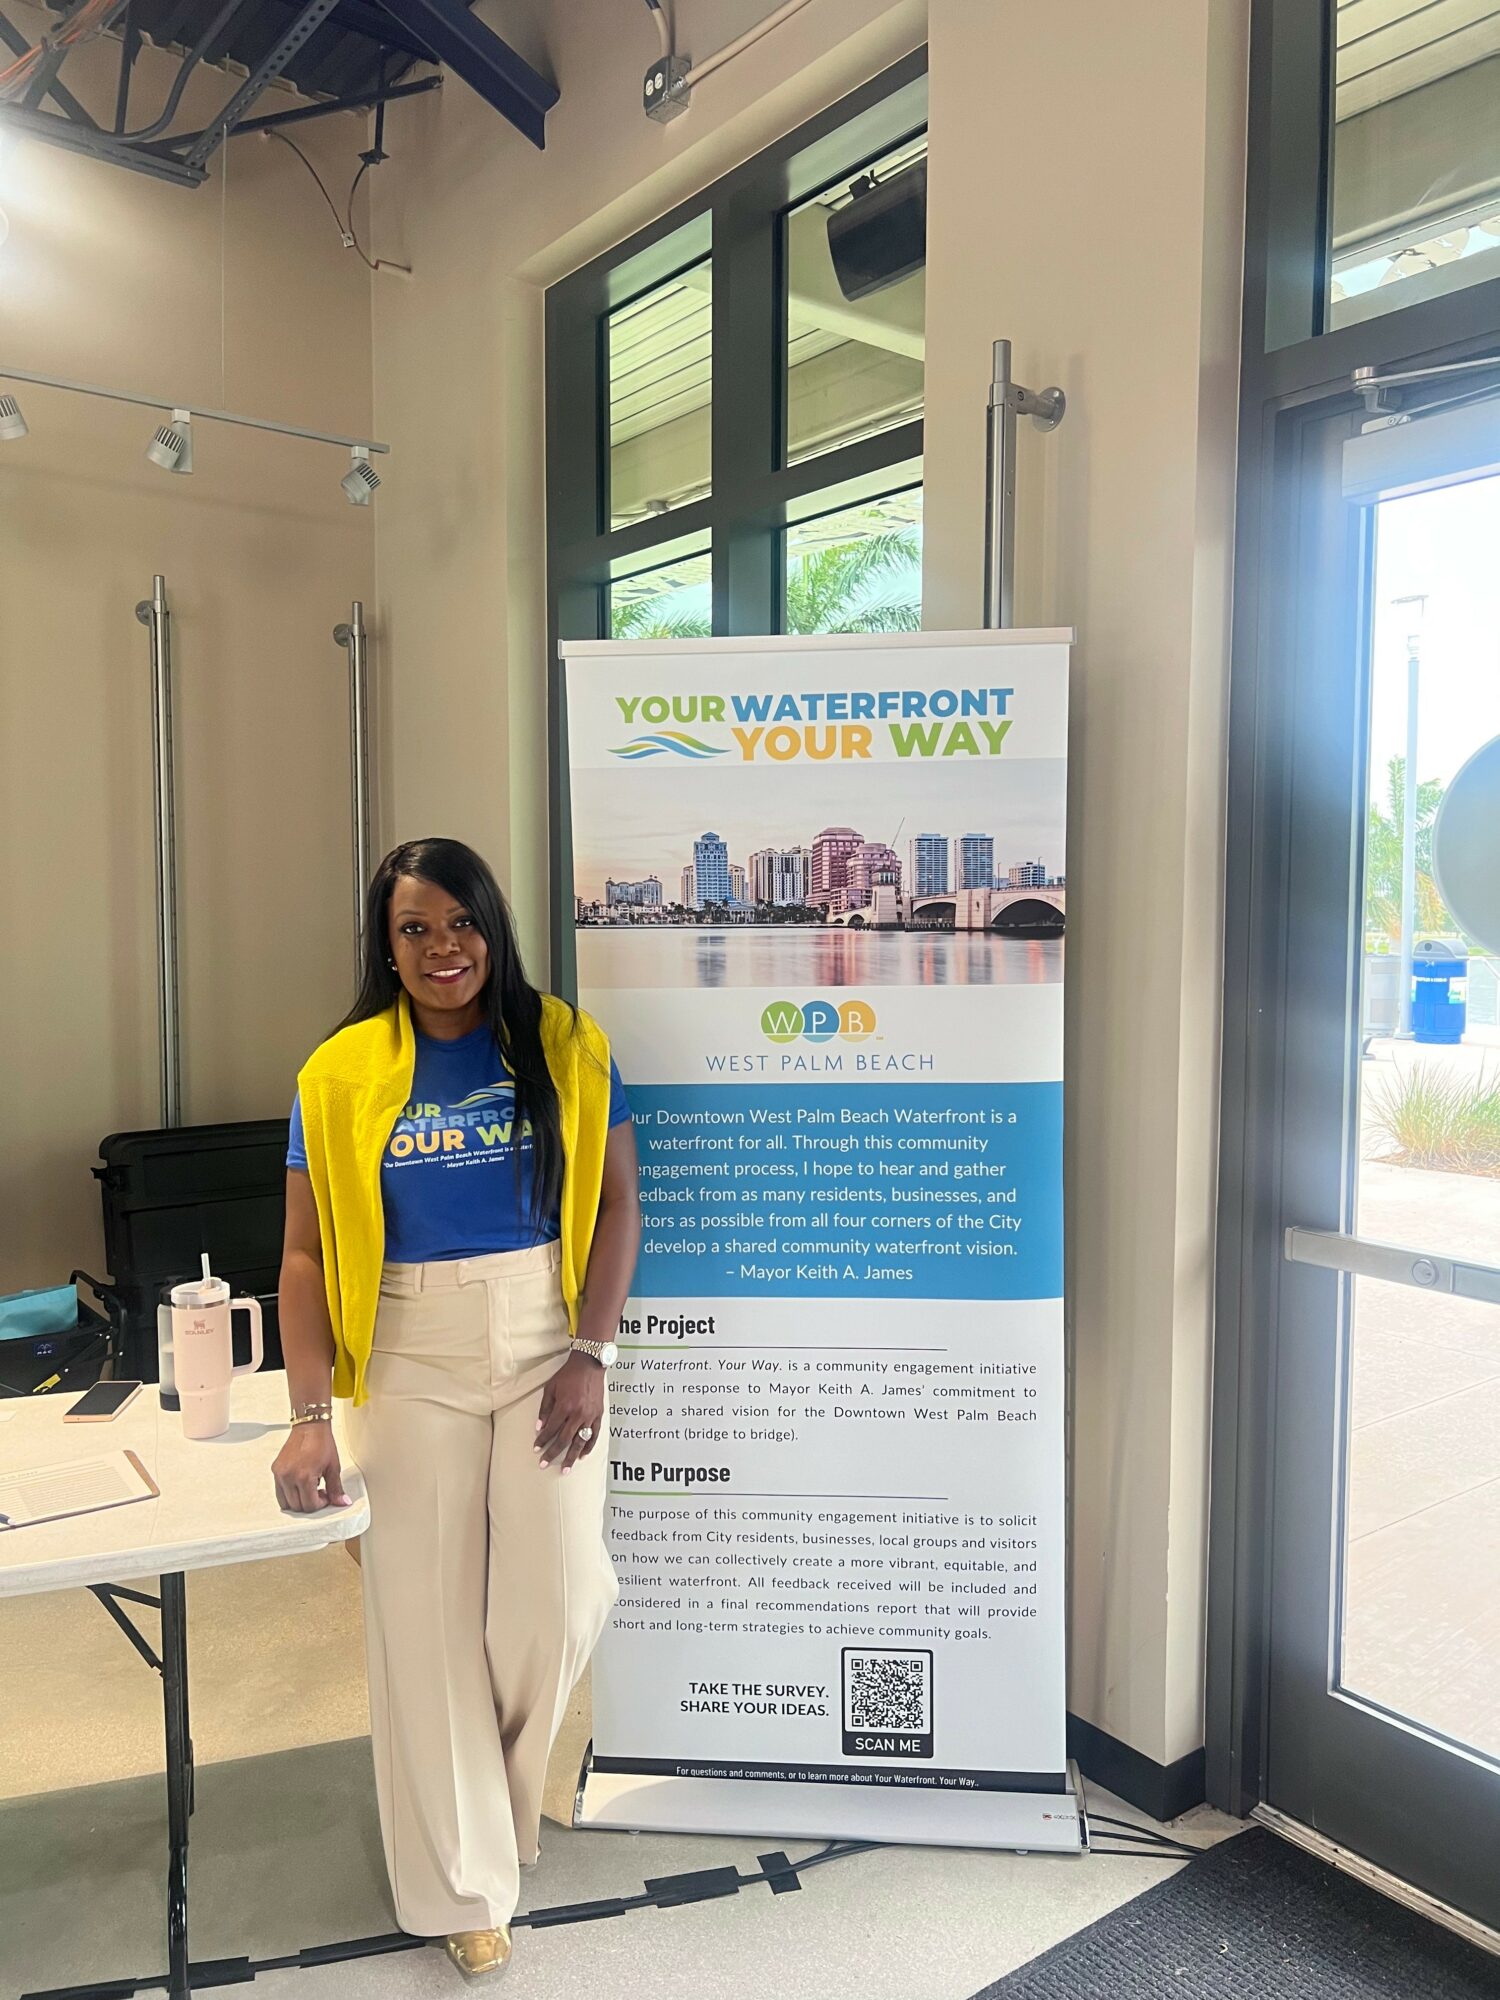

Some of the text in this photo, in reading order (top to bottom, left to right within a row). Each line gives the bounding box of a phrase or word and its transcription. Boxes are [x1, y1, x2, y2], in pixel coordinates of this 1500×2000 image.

[615, 687, 1014, 724] YOUR WATERFRONT
[731, 720, 1013, 761] YOUR WAY
[705, 1053, 933, 1072] WEST PALM BEACH
[632, 1108, 1017, 1125] ur Downtown West Palm Beach Waterfront is a
[389, 1129, 465, 1158] OUR
[648, 1134, 989, 1153] waterfront for all. Through this community
[734, 1164, 798, 1179] process,
[803, 1160, 808, 1175] I
[812, 1160, 853, 1178] hope
[857, 1161, 874, 1176] to
[878, 1160, 915, 1176] hear
[918, 1160, 949, 1176] and
[952, 1161, 1007, 1180] gather
[638, 1186, 1016, 1205] edback from as many residents, businesses, and
[678, 1216, 696, 1228] as
[700, 1212, 764, 1231] possible
[768, 1212, 806, 1228] from
[810, 1212, 828, 1228] all
[832, 1212, 867, 1228] four
[870, 1216, 932, 1228] corners
[935, 1213, 953, 1229] of
[956, 1214, 984, 1229] the
[988, 1214, 1022, 1232] City
[643, 1238, 1018, 1257] develop a shared community waterfront vision.
[740, 1264, 792, 1282] Mayor
[796, 1264, 838, 1280] Keith
[842, 1264, 859, 1280] A.
[863, 1264, 913, 1280] James
[619, 1314, 715, 1340] he Project
[610, 1359, 1037, 1376] our Waterfront. Your Way. is a community engagement initiative
[607, 1380, 655, 1396] directly
[662, 1382, 674, 1394] in
[681, 1384, 740, 1396] response
[747, 1383, 761, 1394] to
[768, 1382, 811, 1396] Mayor
[818, 1383, 853, 1395] Keith
[859, 1383, 874, 1395] A.
[932, 1386, 1016, 1398] commitment
[1023, 1387, 1037, 1398] to
[609, 1403, 1037, 1422] develop a shared vision for the Downtown West Palm Beach
[609, 1426, 798, 1443] Waterfront (bridge to bridge).
[609, 1460, 731, 1487] The Purpose
[609, 1506, 1037, 1527] The purpose of this community engagement initiative is to solicit
[612, 1617, 992, 1641] short and long-term strategies to achieve community goals.
[688, 1682, 829, 1698] TAKE THE SURVEY.
[679, 1700, 829, 1717] SHARE YOUR IDEAS.
[854, 1737, 921, 1752] SCAN ME
[676, 1766, 689, 1775] For
[690, 1768, 728, 1777] questions
[729, 1769, 743, 1778] and
[745, 1770, 787, 1780] comments,
[788, 1772, 797, 1780] or
[798, 1772, 806, 1780] to
[807, 1771, 827, 1781] learn
[829, 1773, 849, 1782] more
[850, 1773, 873, 1782] about
[874, 1774, 892, 1783] Your
[939, 1776, 957, 1785] Your
